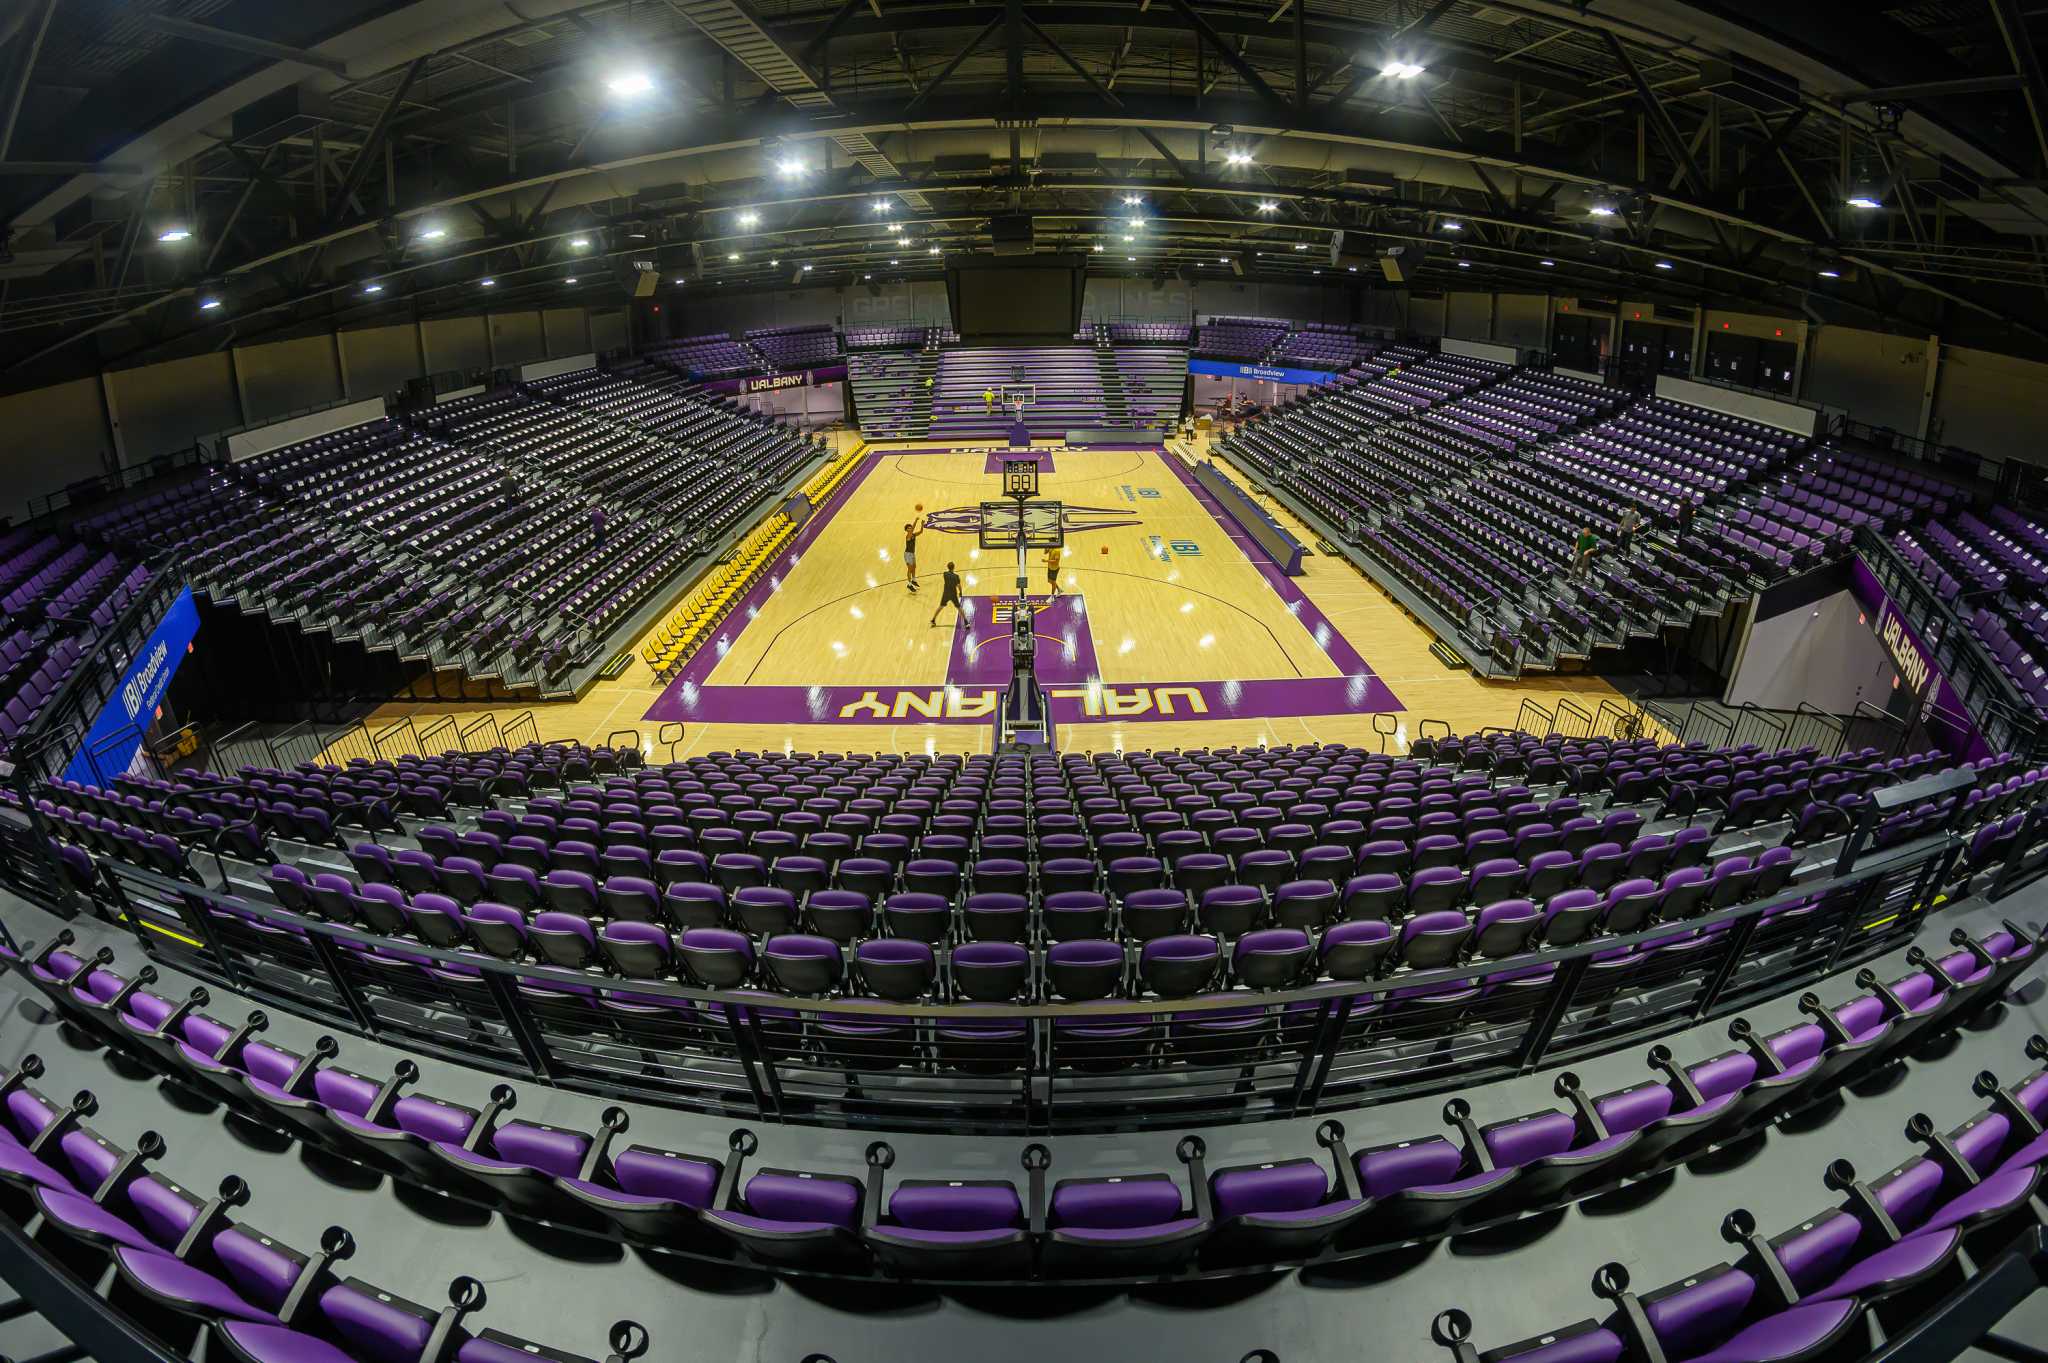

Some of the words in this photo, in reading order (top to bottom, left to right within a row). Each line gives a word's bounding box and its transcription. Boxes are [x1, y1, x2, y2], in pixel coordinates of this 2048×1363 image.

[750, 374, 803, 391] UALBANY
[136, 639, 169, 695] Broadview
[1883, 612, 1929, 694] UALBANY
[838, 689, 1209, 718] UALANY
